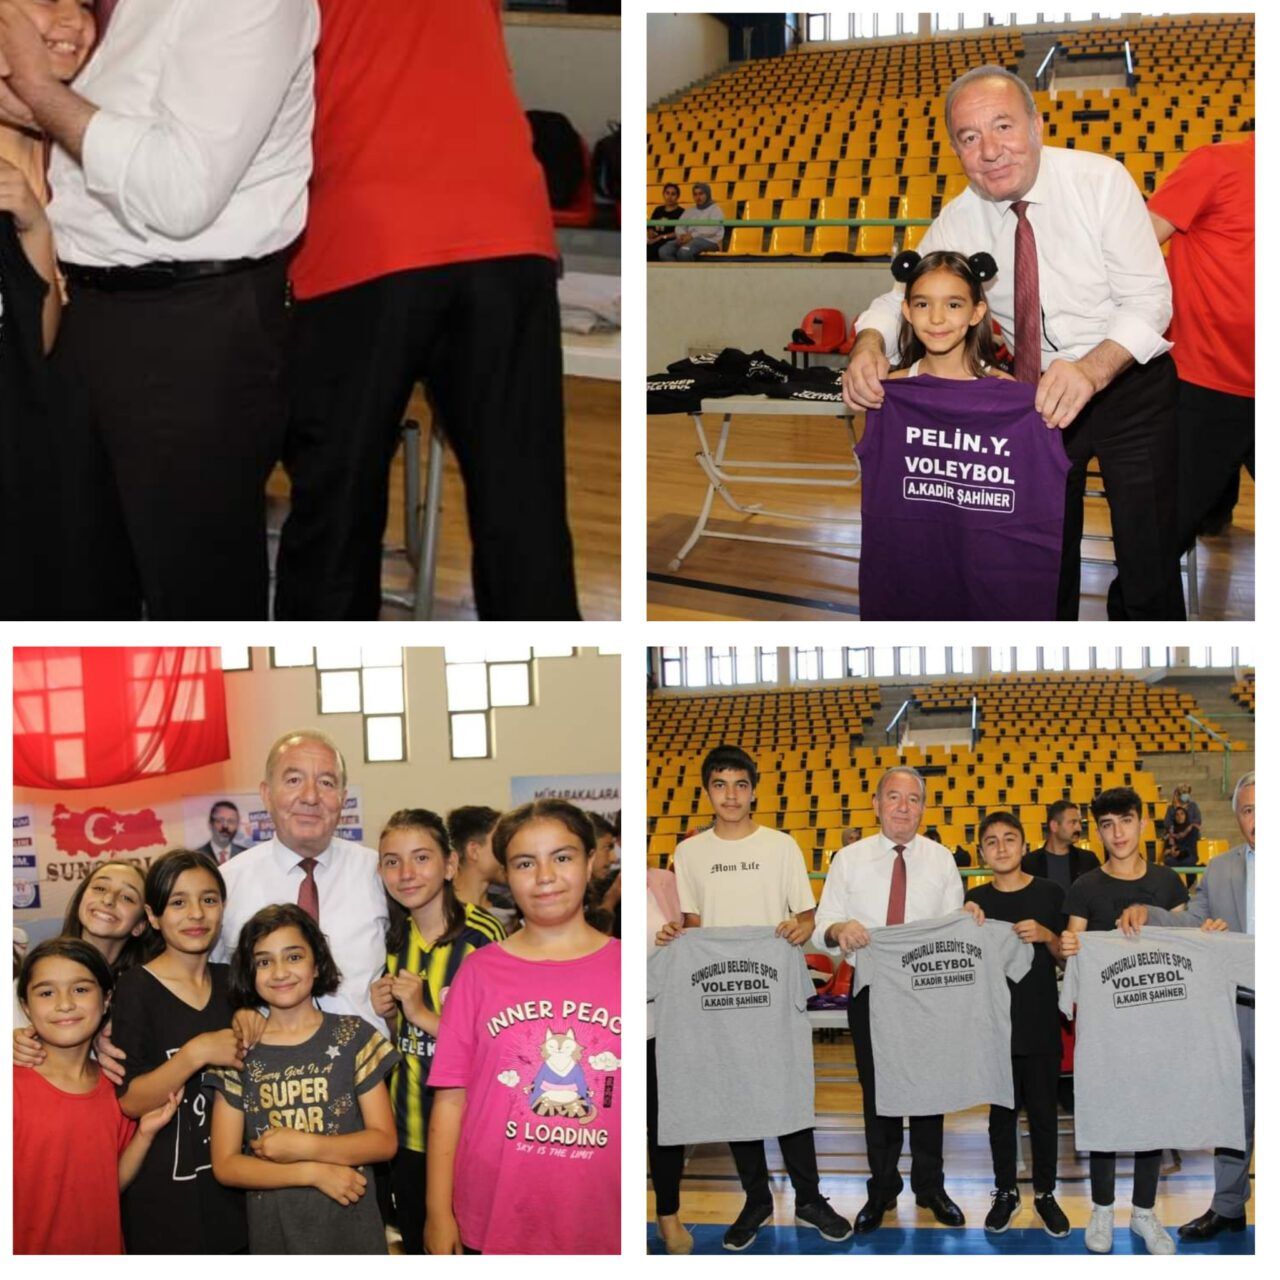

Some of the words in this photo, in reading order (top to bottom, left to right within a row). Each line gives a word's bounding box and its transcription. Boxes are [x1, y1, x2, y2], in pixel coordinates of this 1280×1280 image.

[906, 426, 1011, 457] PELİN.Y.
[904, 456, 1015, 485] VOLEYBOL
[907, 482, 954, 500] A.KADİR
[957, 489, 1010, 507] ŞAHİNER
[710, 863, 737, 874] Mom
[741, 861, 760, 871] Life
[902, 941, 934, 968] SUNGURLU
[935, 938, 965, 954] BELEDİYE
[966, 943, 982, 960] SPOR
[911, 958, 975, 973] VOLEYBOL
[692, 961, 726, 987] SUNGURLU
[727, 958, 759, 974] BELEDİYE
[760, 963, 778, 982] SPOR
[1101, 954, 1136, 984] SUNGURLU
[1137, 948, 1171, 966] BELEDİYE
[1171, 953, 1193, 972] SPOR
[701, 979, 769, 993] VOLEYBOL
[914, 976, 942, 987] A.KADİR
[944, 972, 973, 986] ŞAHİNER
[1112, 970, 1184, 989] VOLEYBOL
[704, 996, 734, 1008] A.KADİR
[735, 994, 768, 1007] ŞAHİNER
[1117, 990, 1147, 1005] A.KADİR
[1149, 987, 1184, 1002] ŞAHİNER
[486, 1000, 554, 1037] INNER
[255, 1070, 280, 1082] Every
[284, 1065, 305, 1079] Girl
[308, 1063, 319, 1074] Is
[260, 1077, 328, 1108] SUPER
[268, 1106, 324, 1132] STAR
[525, 1122, 608, 1147] LOADING
[516, 1142, 533, 1153] SKY
[537, 1144, 546, 1154] IS
[549, 1146, 567, 1158] THE
[570, 1149, 594, 1159] LIMIT
